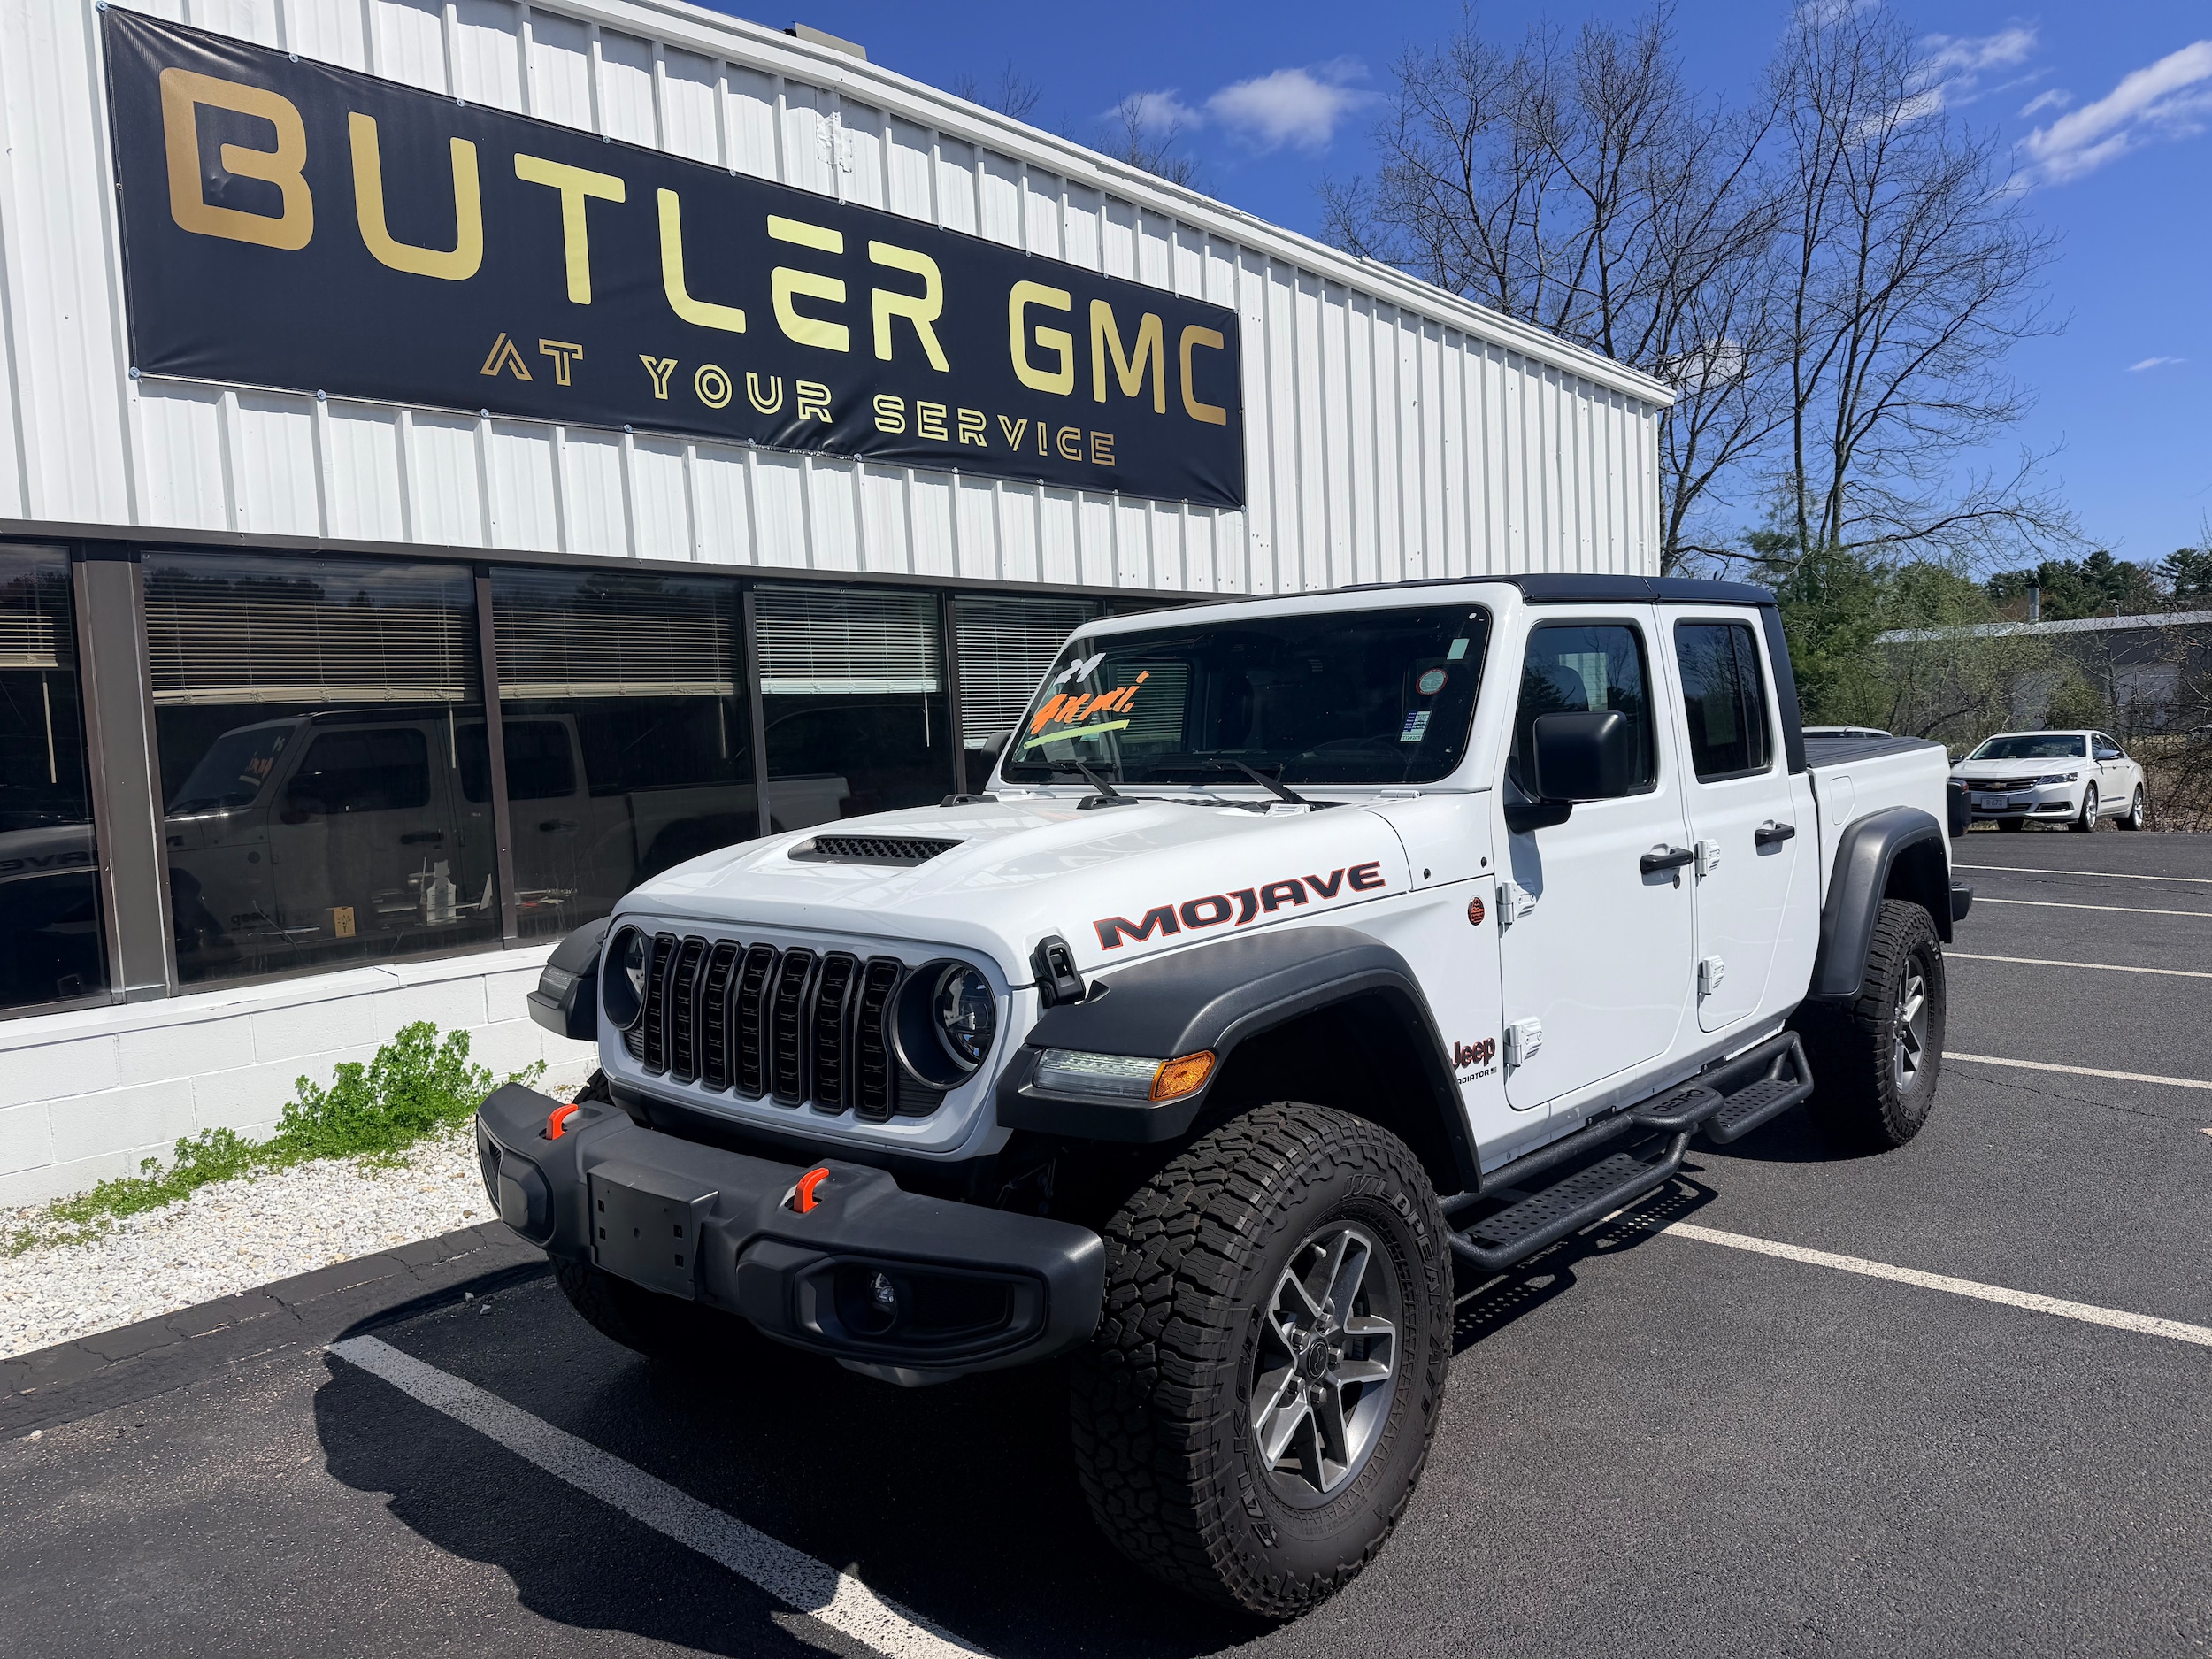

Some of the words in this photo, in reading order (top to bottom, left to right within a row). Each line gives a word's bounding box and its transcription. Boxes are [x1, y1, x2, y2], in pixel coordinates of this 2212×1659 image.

[159, 67, 949, 372] BUTLER
[1008, 280, 1226, 426] GMC
[480, 332, 584, 387] AT
[639, 354, 833, 423] YOUR
[872, 393, 1116, 466] SERVICE
[1093, 861, 1386, 951] MOJAVE
[1451, 1037, 1495, 1071] Jeep
